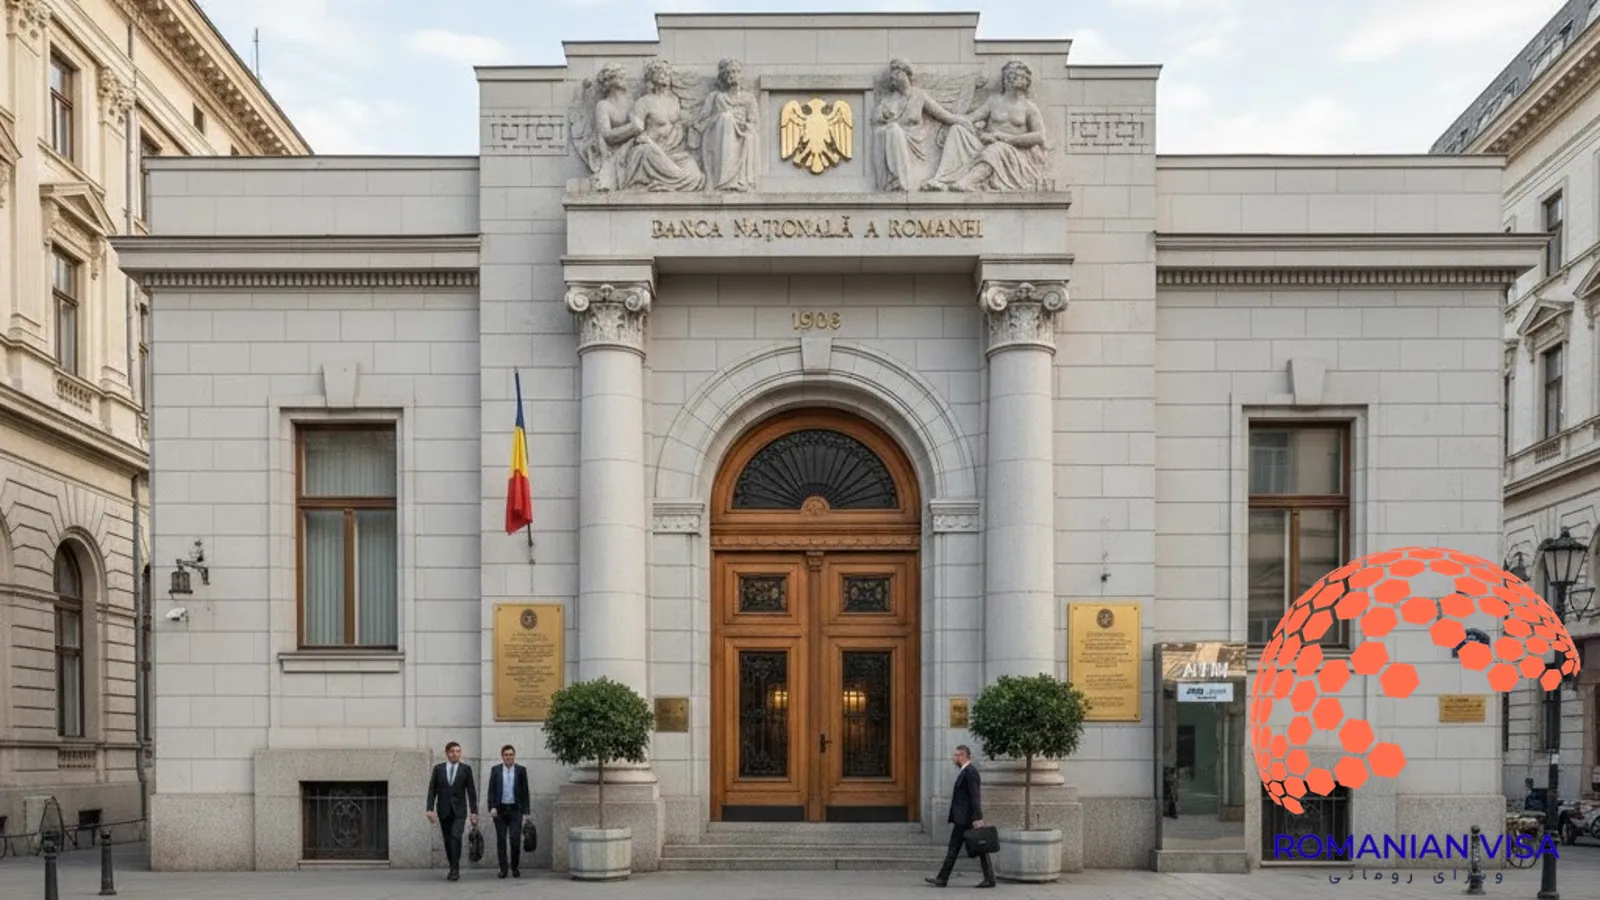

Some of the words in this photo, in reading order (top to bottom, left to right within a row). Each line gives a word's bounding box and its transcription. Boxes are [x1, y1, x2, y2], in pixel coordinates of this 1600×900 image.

[651, 219, 723, 239] BANCA
[864, 219, 880, 238] A
[1182, 661, 1229, 678] ATM
